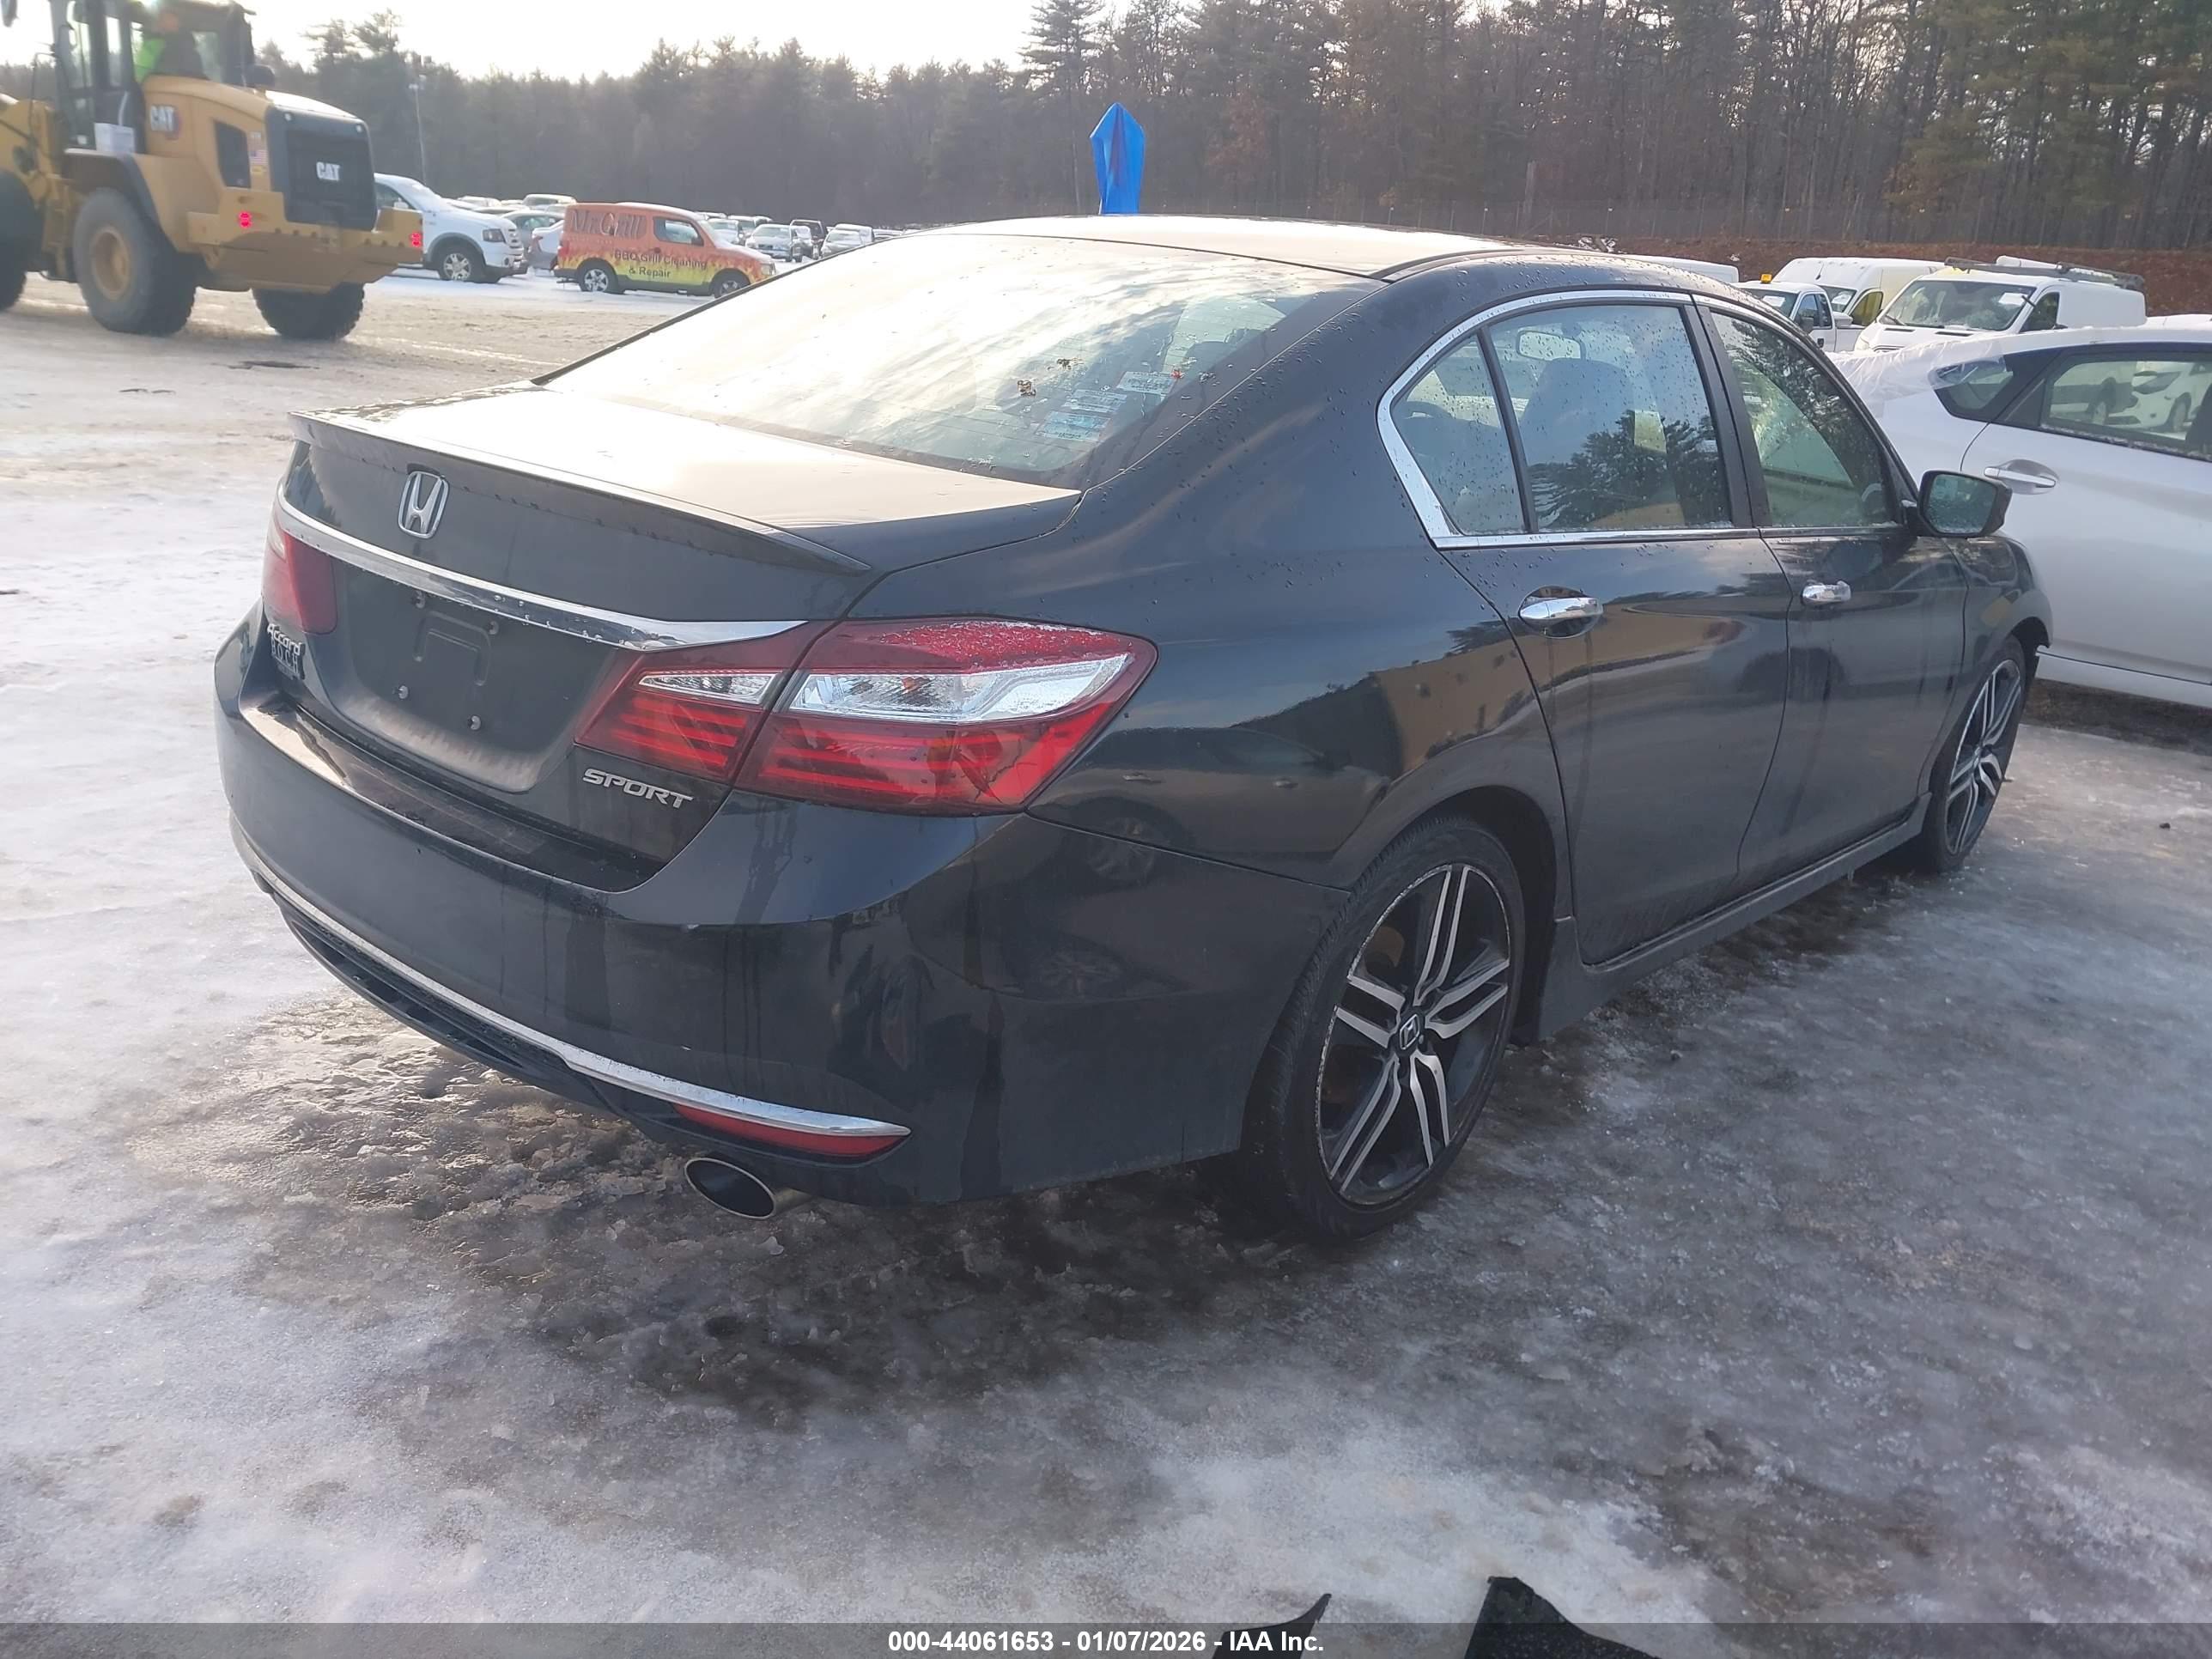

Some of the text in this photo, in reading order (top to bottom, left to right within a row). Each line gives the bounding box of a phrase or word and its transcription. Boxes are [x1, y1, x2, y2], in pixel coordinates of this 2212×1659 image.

[150, 106, 174, 131] CAT
[316, 161, 341, 181] CAT
[614, 249, 707, 270] BBQ Grill Cleaning
[639, 267, 672, 280] Repair
[267, 623, 303, 656] Accord
[582, 769, 695, 809] SPORT
